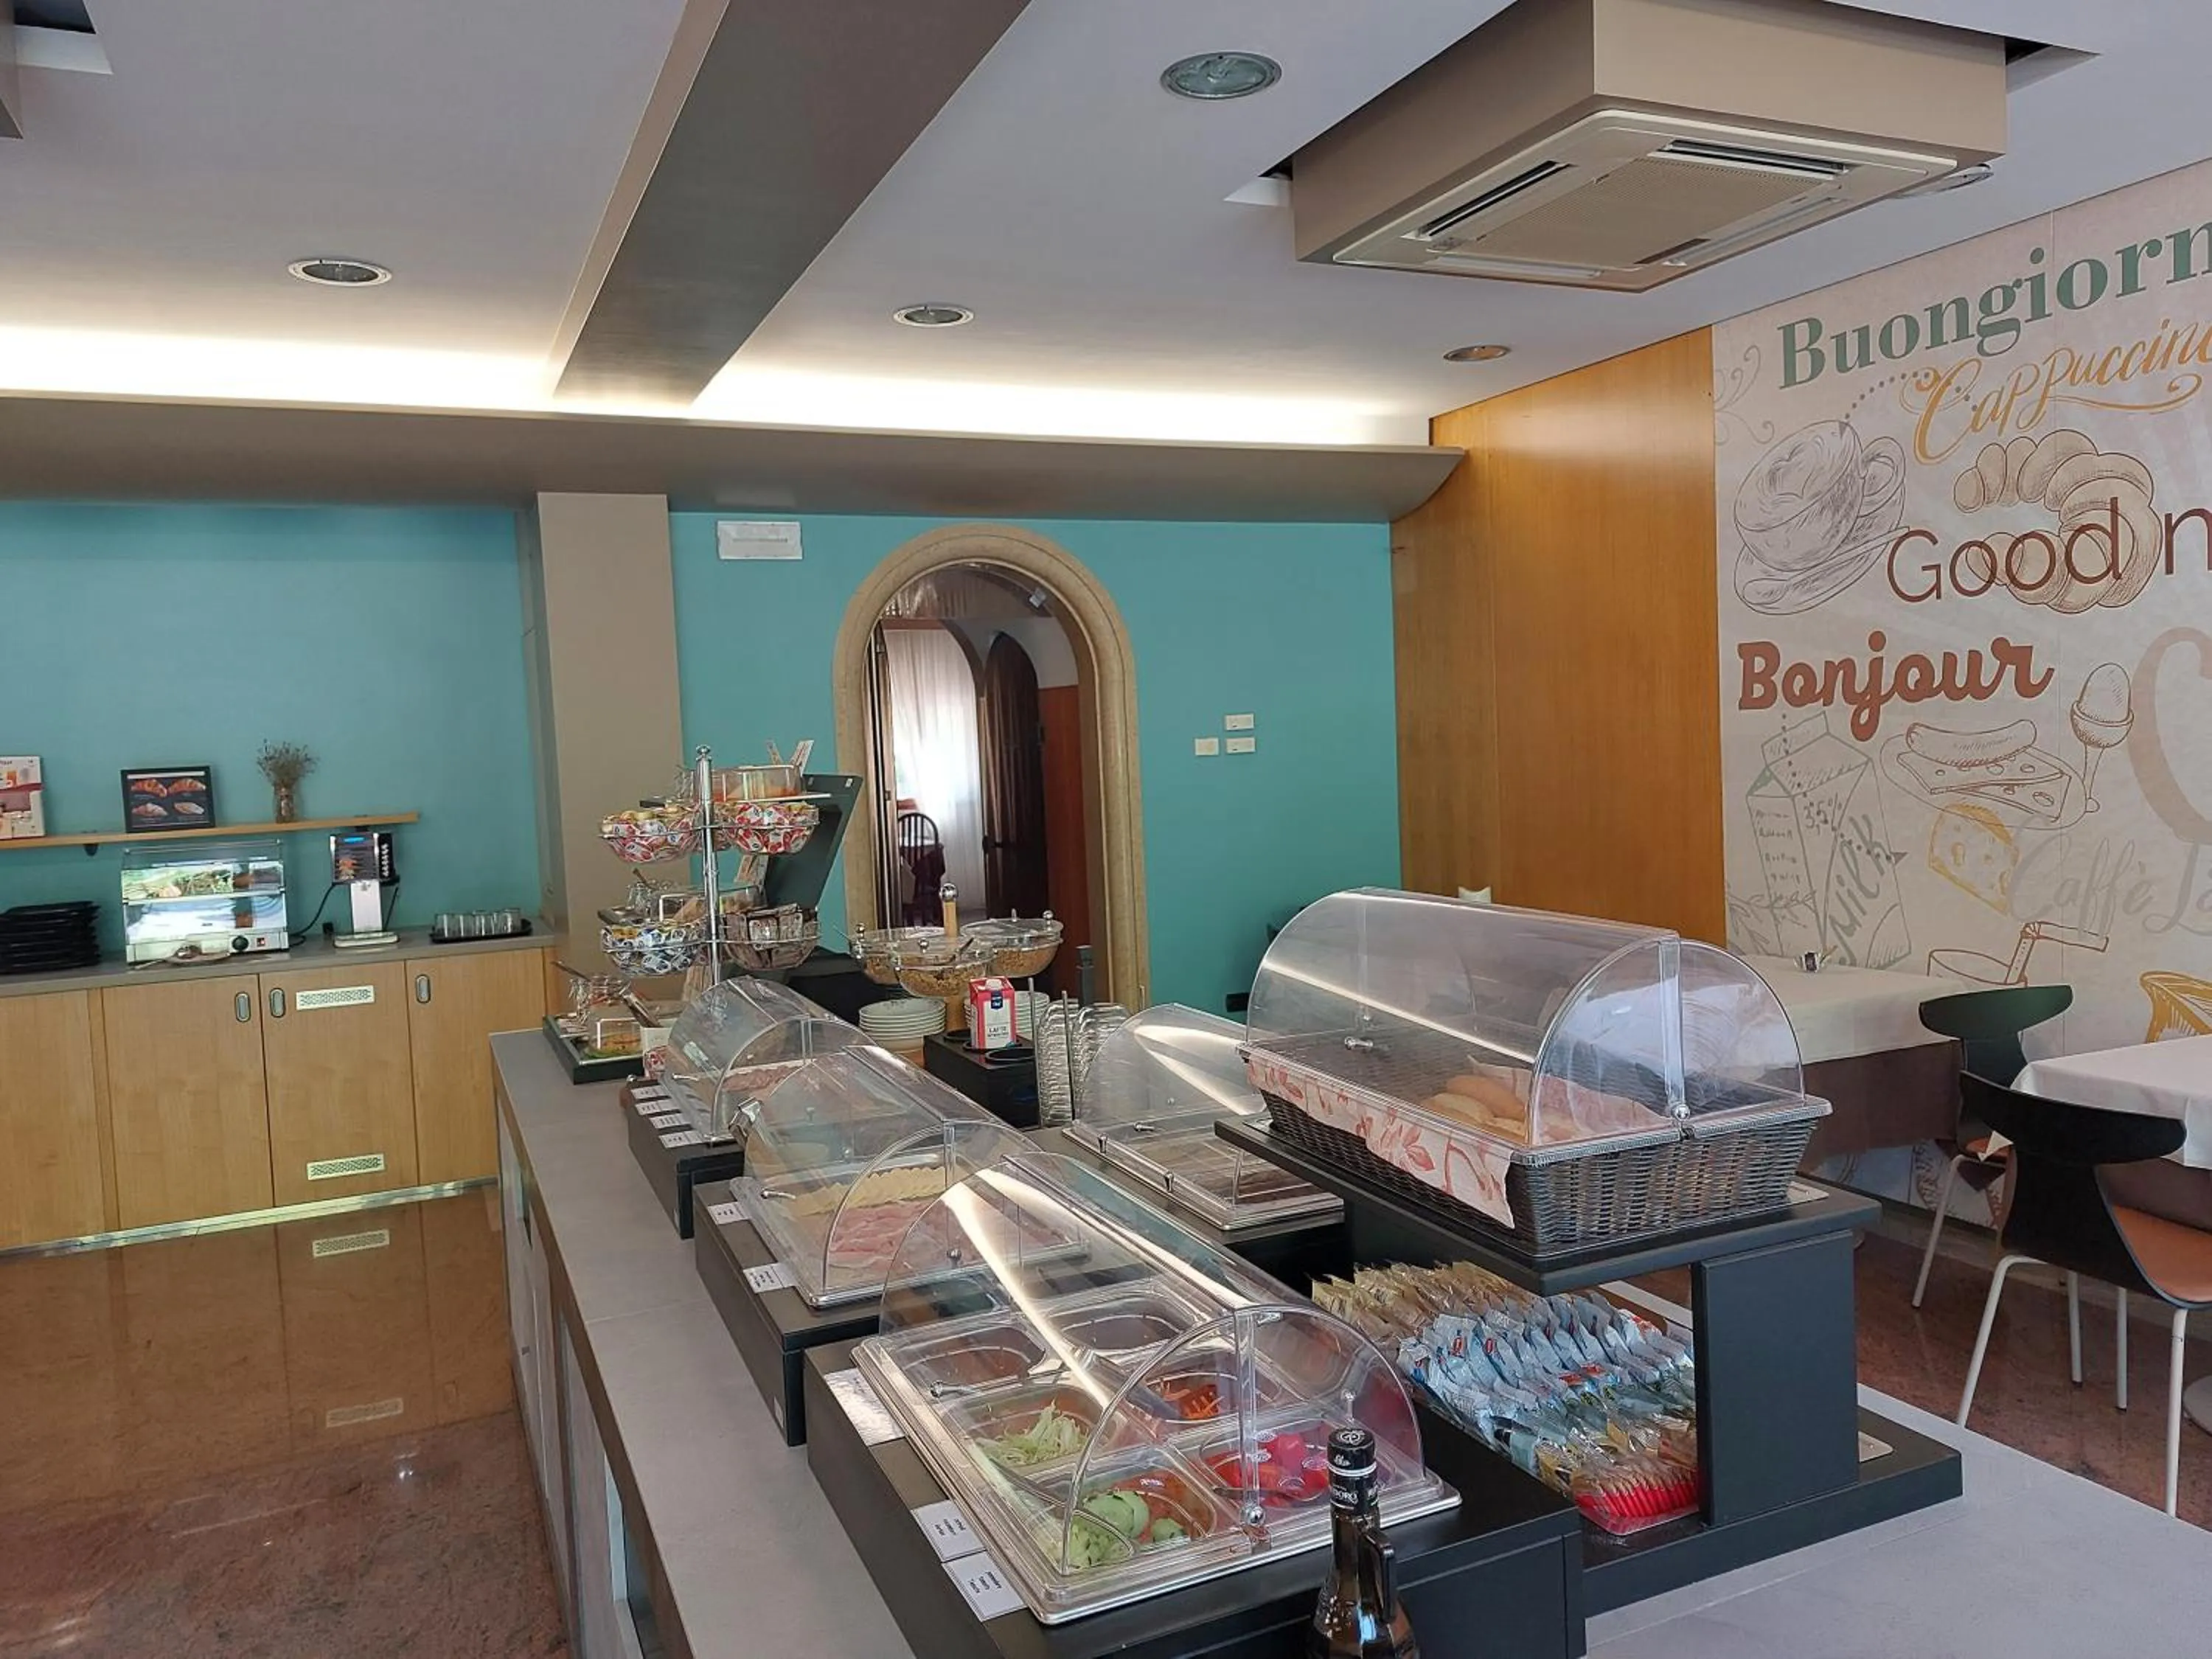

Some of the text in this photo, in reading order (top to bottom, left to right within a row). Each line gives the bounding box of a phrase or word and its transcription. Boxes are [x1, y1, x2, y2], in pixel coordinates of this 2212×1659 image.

[1887, 496, 2122, 603] Good
[1738, 630, 2055, 742] Bonjour
[1829, 813, 1893, 967] Milk
